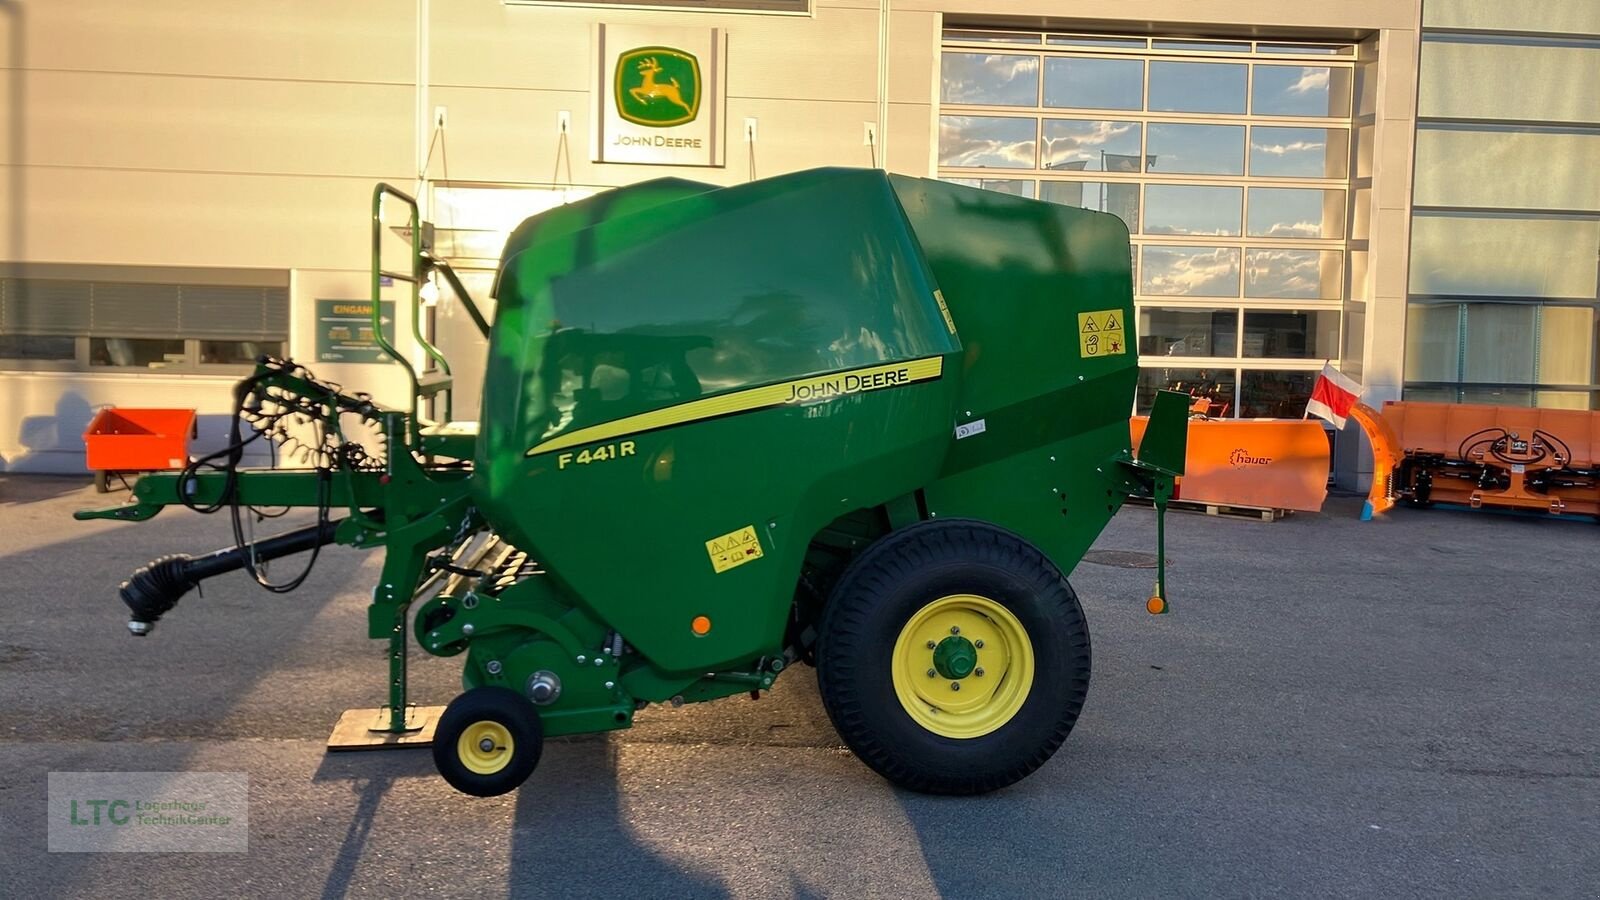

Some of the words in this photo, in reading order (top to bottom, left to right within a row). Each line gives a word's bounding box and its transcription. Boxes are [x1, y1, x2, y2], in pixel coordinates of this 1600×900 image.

[613, 134, 652, 146] JOHN
[654, 135, 702, 149] DEERE
[333, 305, 374, 315] EINGAN
[784, 379, 840, 402] JOHN
[845, 368, 909, 391] DEERE
[558, 452, 573, 469] F
[576, 444, 616, 464] 441
[620, 440, 636, 457] R
[1236, 453, 1272, 465] hauer
